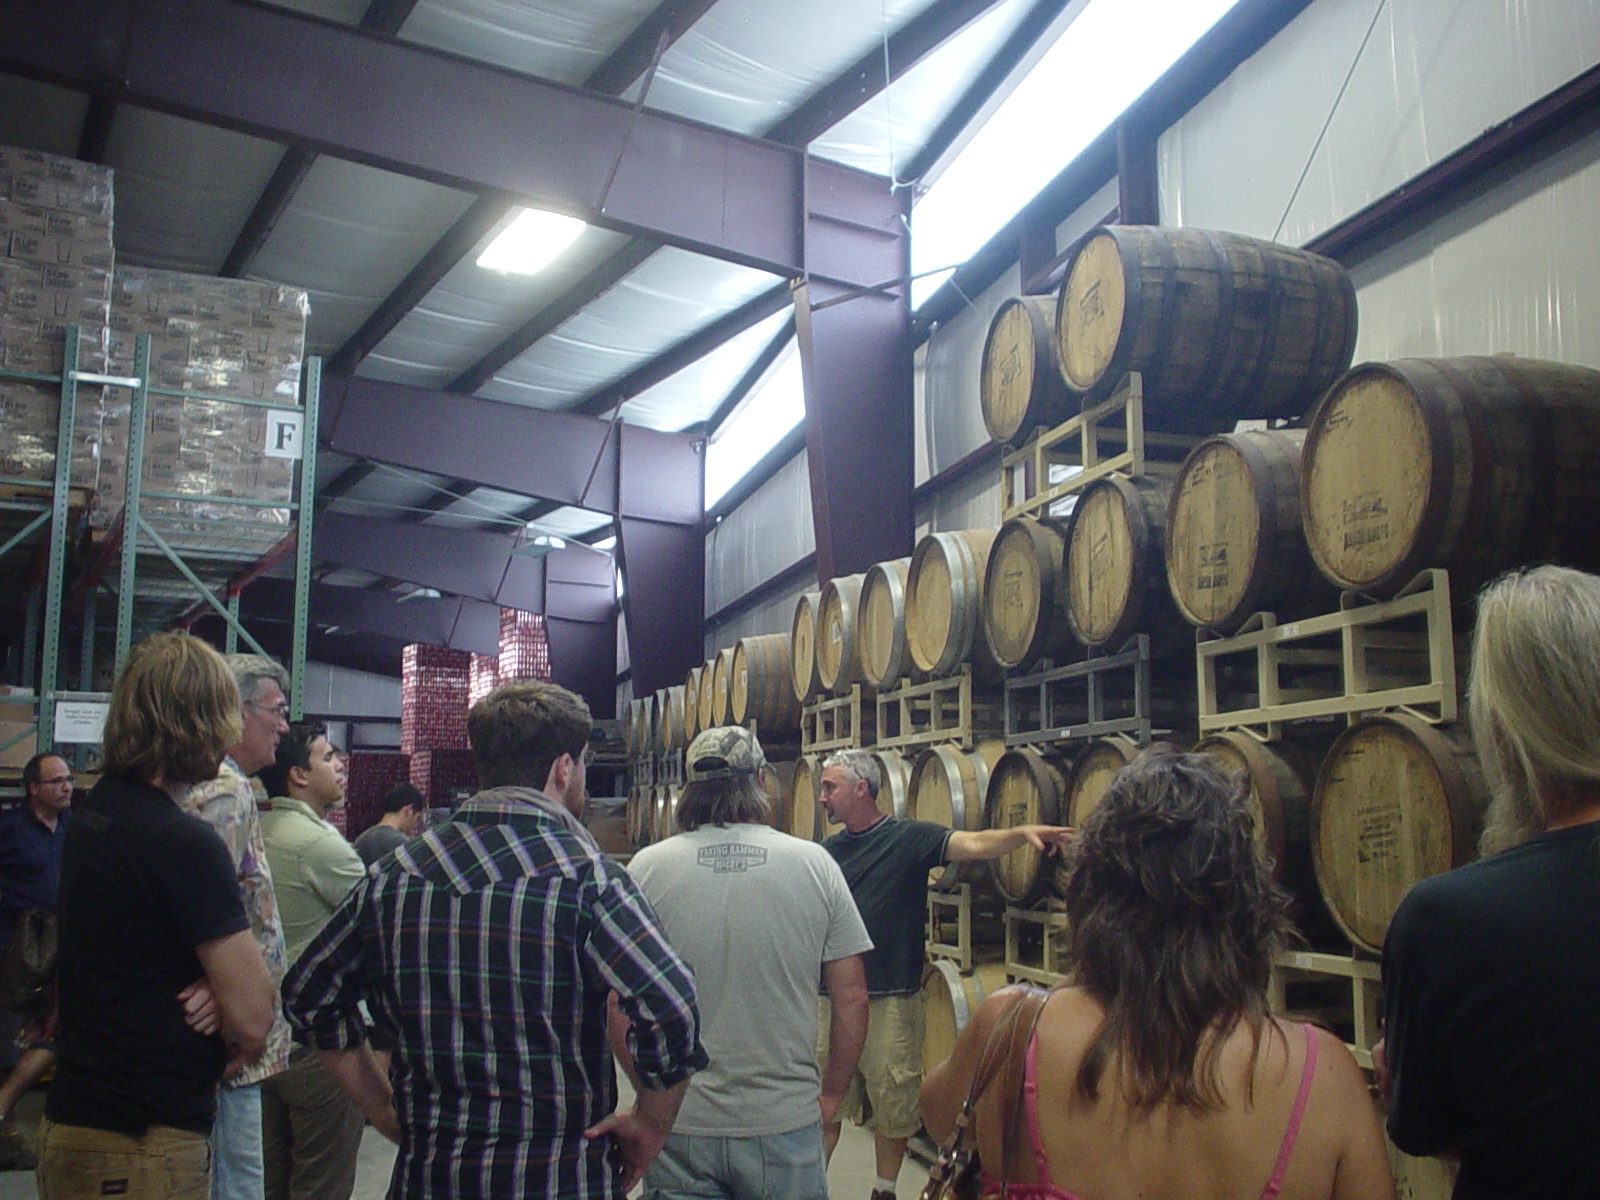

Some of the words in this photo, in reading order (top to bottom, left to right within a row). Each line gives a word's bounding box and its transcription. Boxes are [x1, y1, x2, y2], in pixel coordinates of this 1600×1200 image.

[274, 422, 296, 450] F
[700, 845, 728, 858] FLYING
[729, 844, 764, 856] HAMMER
